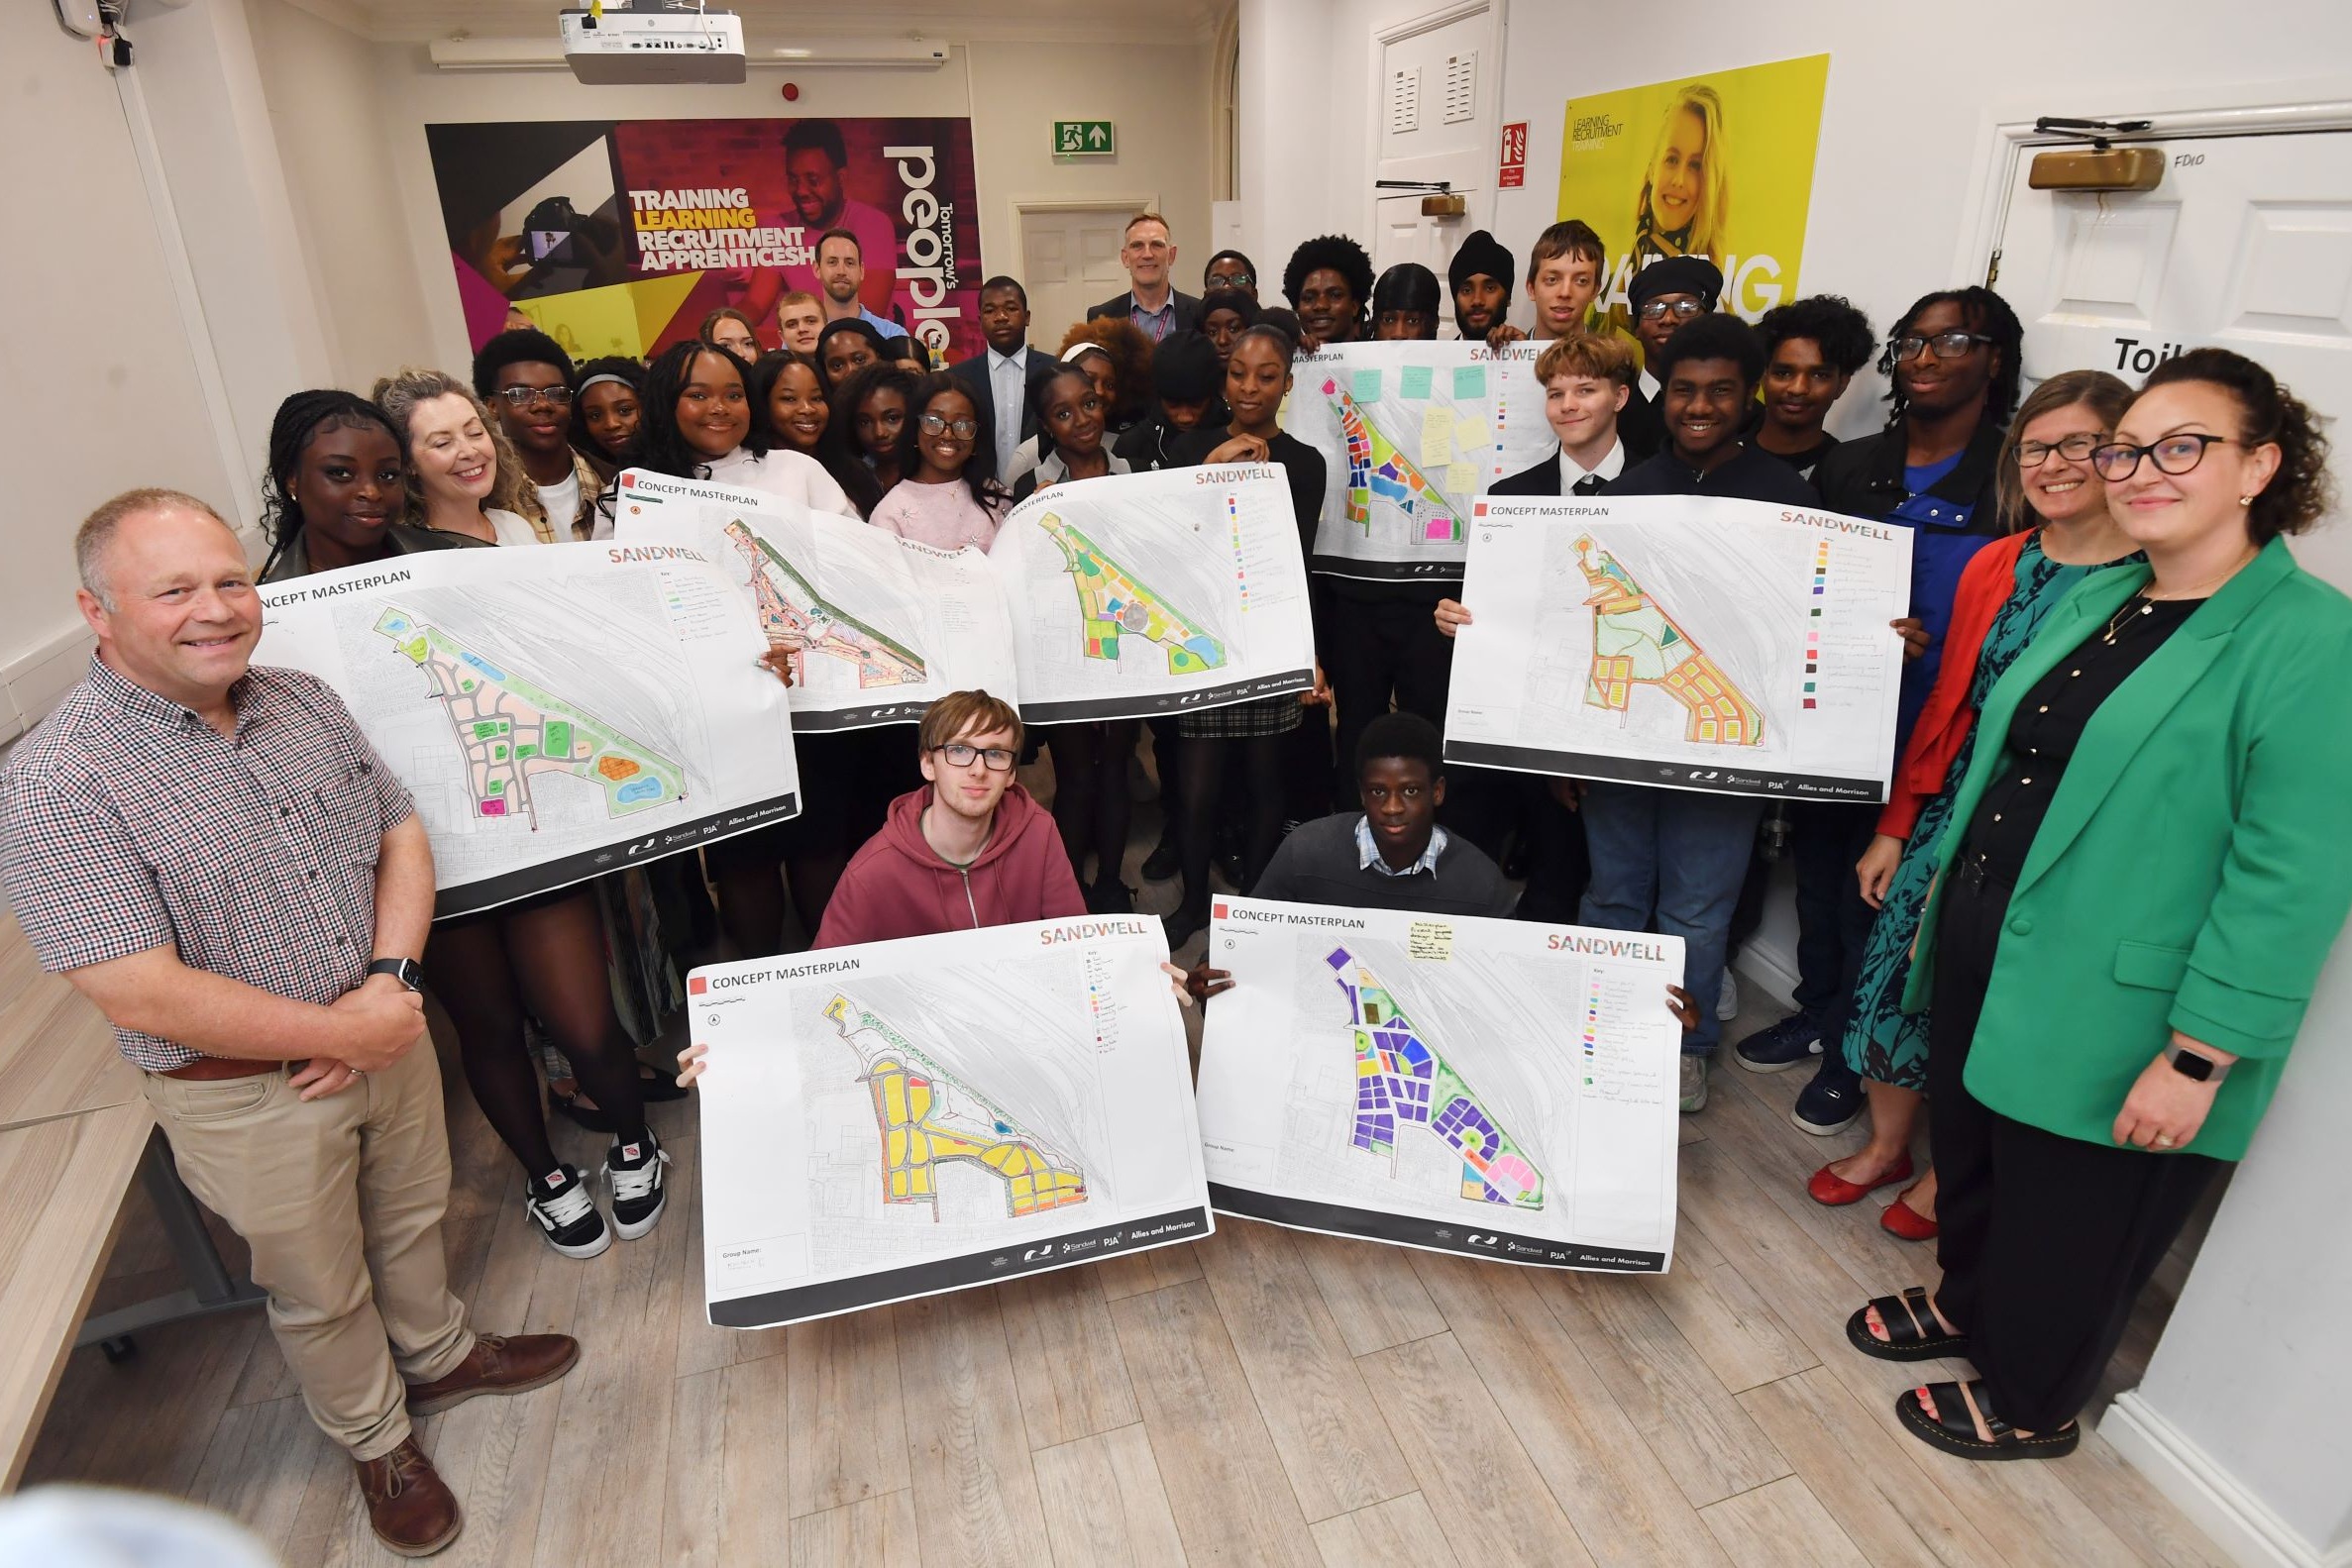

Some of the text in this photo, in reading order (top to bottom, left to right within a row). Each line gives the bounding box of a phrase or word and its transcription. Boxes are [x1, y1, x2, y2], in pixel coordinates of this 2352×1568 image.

[1572, 124, 1624, 141] RECRUITMENT
[1573, 114, 1610, 130] LEARNING
[628, 188, 749, 211] TRAINING
[633, 208, 757, 231] LEARNING
[636, 227, 804, 252] RECRUITMENT
[884, 147, 961, 355] people
[939, 203, 959, 290] Tomorrow's
[641, 247, 815, 270] APPRENTICESH
[1293, 353, 1343, 364] MASTERPLAN
[1470, 348, 1540, 361] SANDWE
[1196, 468, 1275, 484] SANDWELL
[638, 480, 758, 506] CONCEPT MASTERPLAN
[1491, 506, 1609, 516] CONCEPT MASTERPLAN
[1779, 511, 1893, 541] SANDWELL
[608, 546, 709, 564] SANDWELL
[261, 569, 411, 609] NCEPT MASTERPLAN
[1797, 784, 1818, 792] Allies
[1835, 787, 1870, 796] Morrison
[702, 825, 717, 835] PJA
[728, 817, 746, 827] Allies
[746, 811, 759, 820] and
[759, 804, 787, 817] Morrison
[1232, 909, 1365, 929] CONCEPT MASTERPLAN
[1040, 921, 1147, 945] SANDWELL
[1548, 934, 1665, 962] SANDWELL
[712, 959, 860, 990] CONCEPT MASTERPLAN
[1104, 1237, 1120, 1247] PJA
[1130, 1230, 1150, 1240] Allies
[1150, 1226, 1164, 1236] and
[1165, 1220, 1196, 1233] Morrison
[1516, 1244, 1543, 1255] Sandwell
[1550, 1251, 1566, 1260] PJA
[1579, 1254, 1600, 1263] Allies
